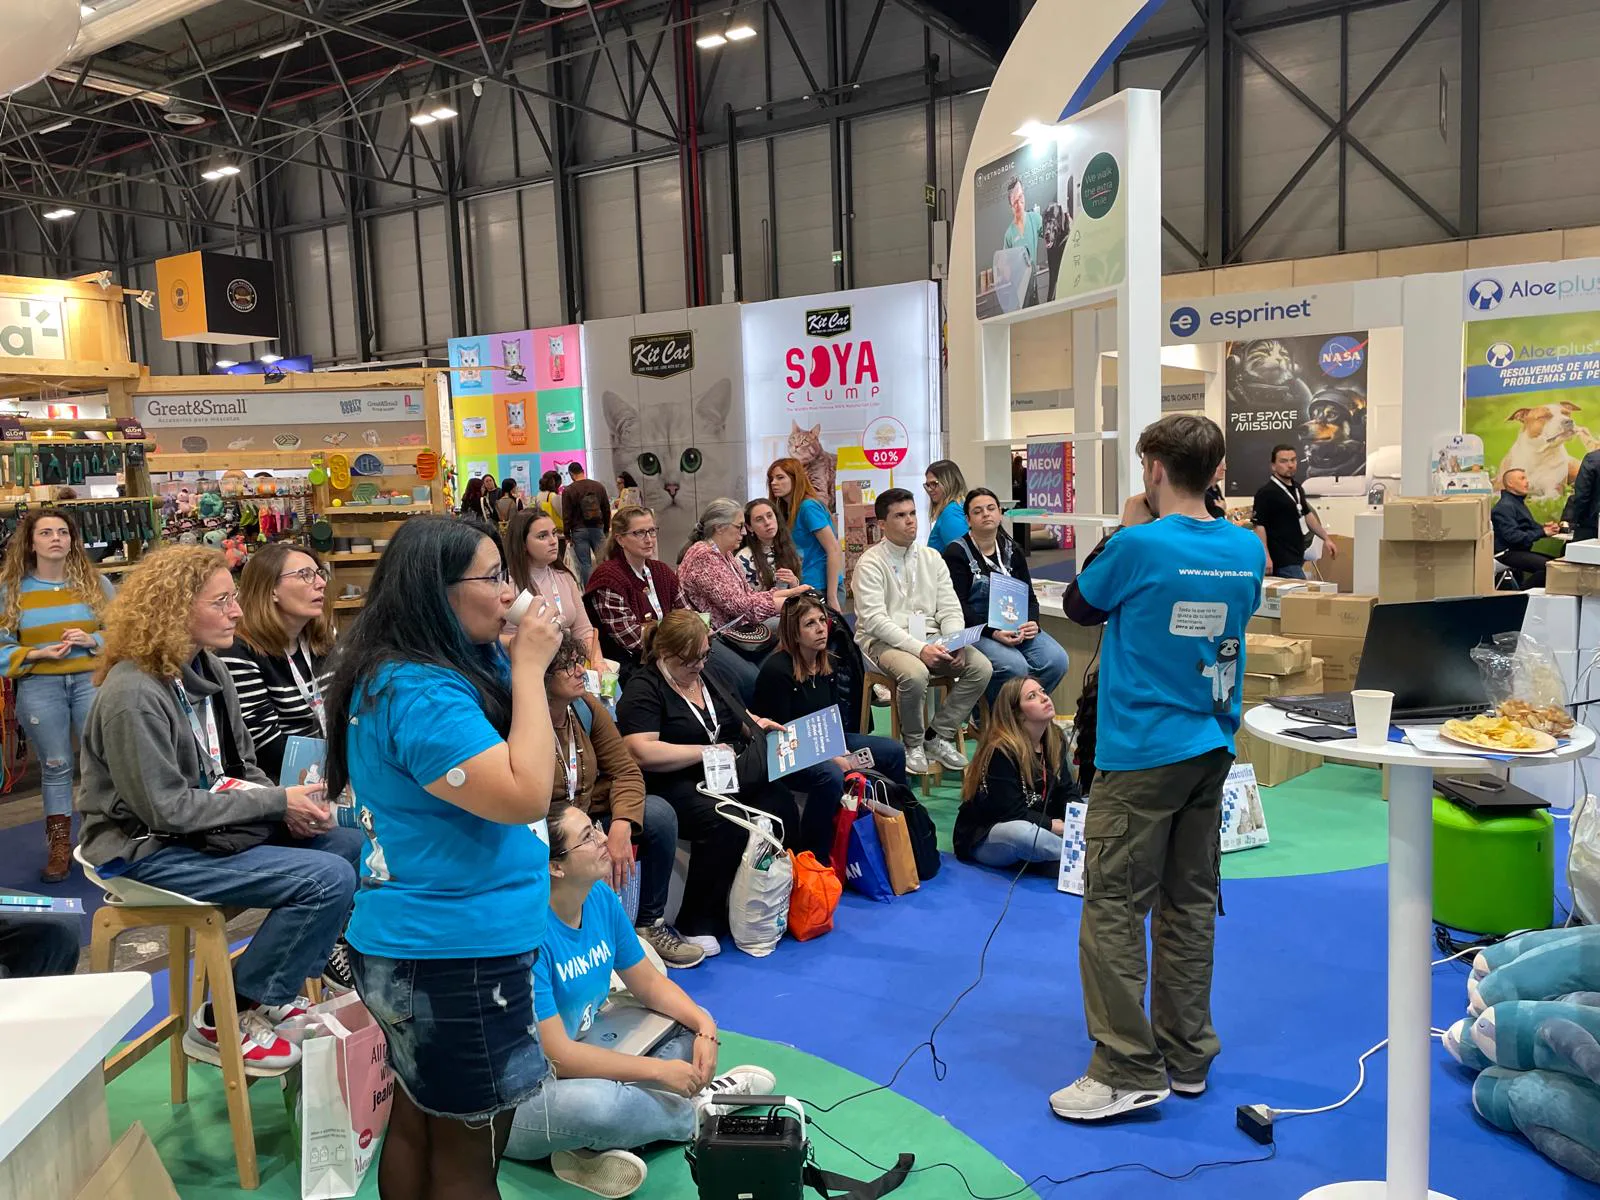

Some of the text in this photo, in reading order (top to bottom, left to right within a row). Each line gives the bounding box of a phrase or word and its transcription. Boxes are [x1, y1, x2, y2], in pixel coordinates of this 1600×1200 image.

[983, 161, 1016, 181] VETNORDIC
[807, 313, 849, 330] Kit Cat
[1210, 300, 1311, 328] esprinet
[633, 341, 690, 366] Kit Cat
[1322, 351, 1361, 365] NASA
[1519, 342, 1594, 361] Aloeplus
[786, 341, 879, 389] SOYA
[1500, 360, 1600, 378] RESOLVEMOS DE MA
[1503, 369, 1600, 387] PROBLEMAS DE PE
[147, 399, 247, 416] Great&Small
[1231, 410, 1298, 423] PET SPACE
[1235, 420, 1293, 432] MISSION
[873, 451, 898, 462] 80%
[1029, 457, 1062, 470] MEOW
[1029, 492, 1062, 507] HOLA
[1178, 568, 1254, 578] www.wakyma.com
[556, 940, 612, 982] WAKYMA
[373, 1081, 393, 1112] jealo
